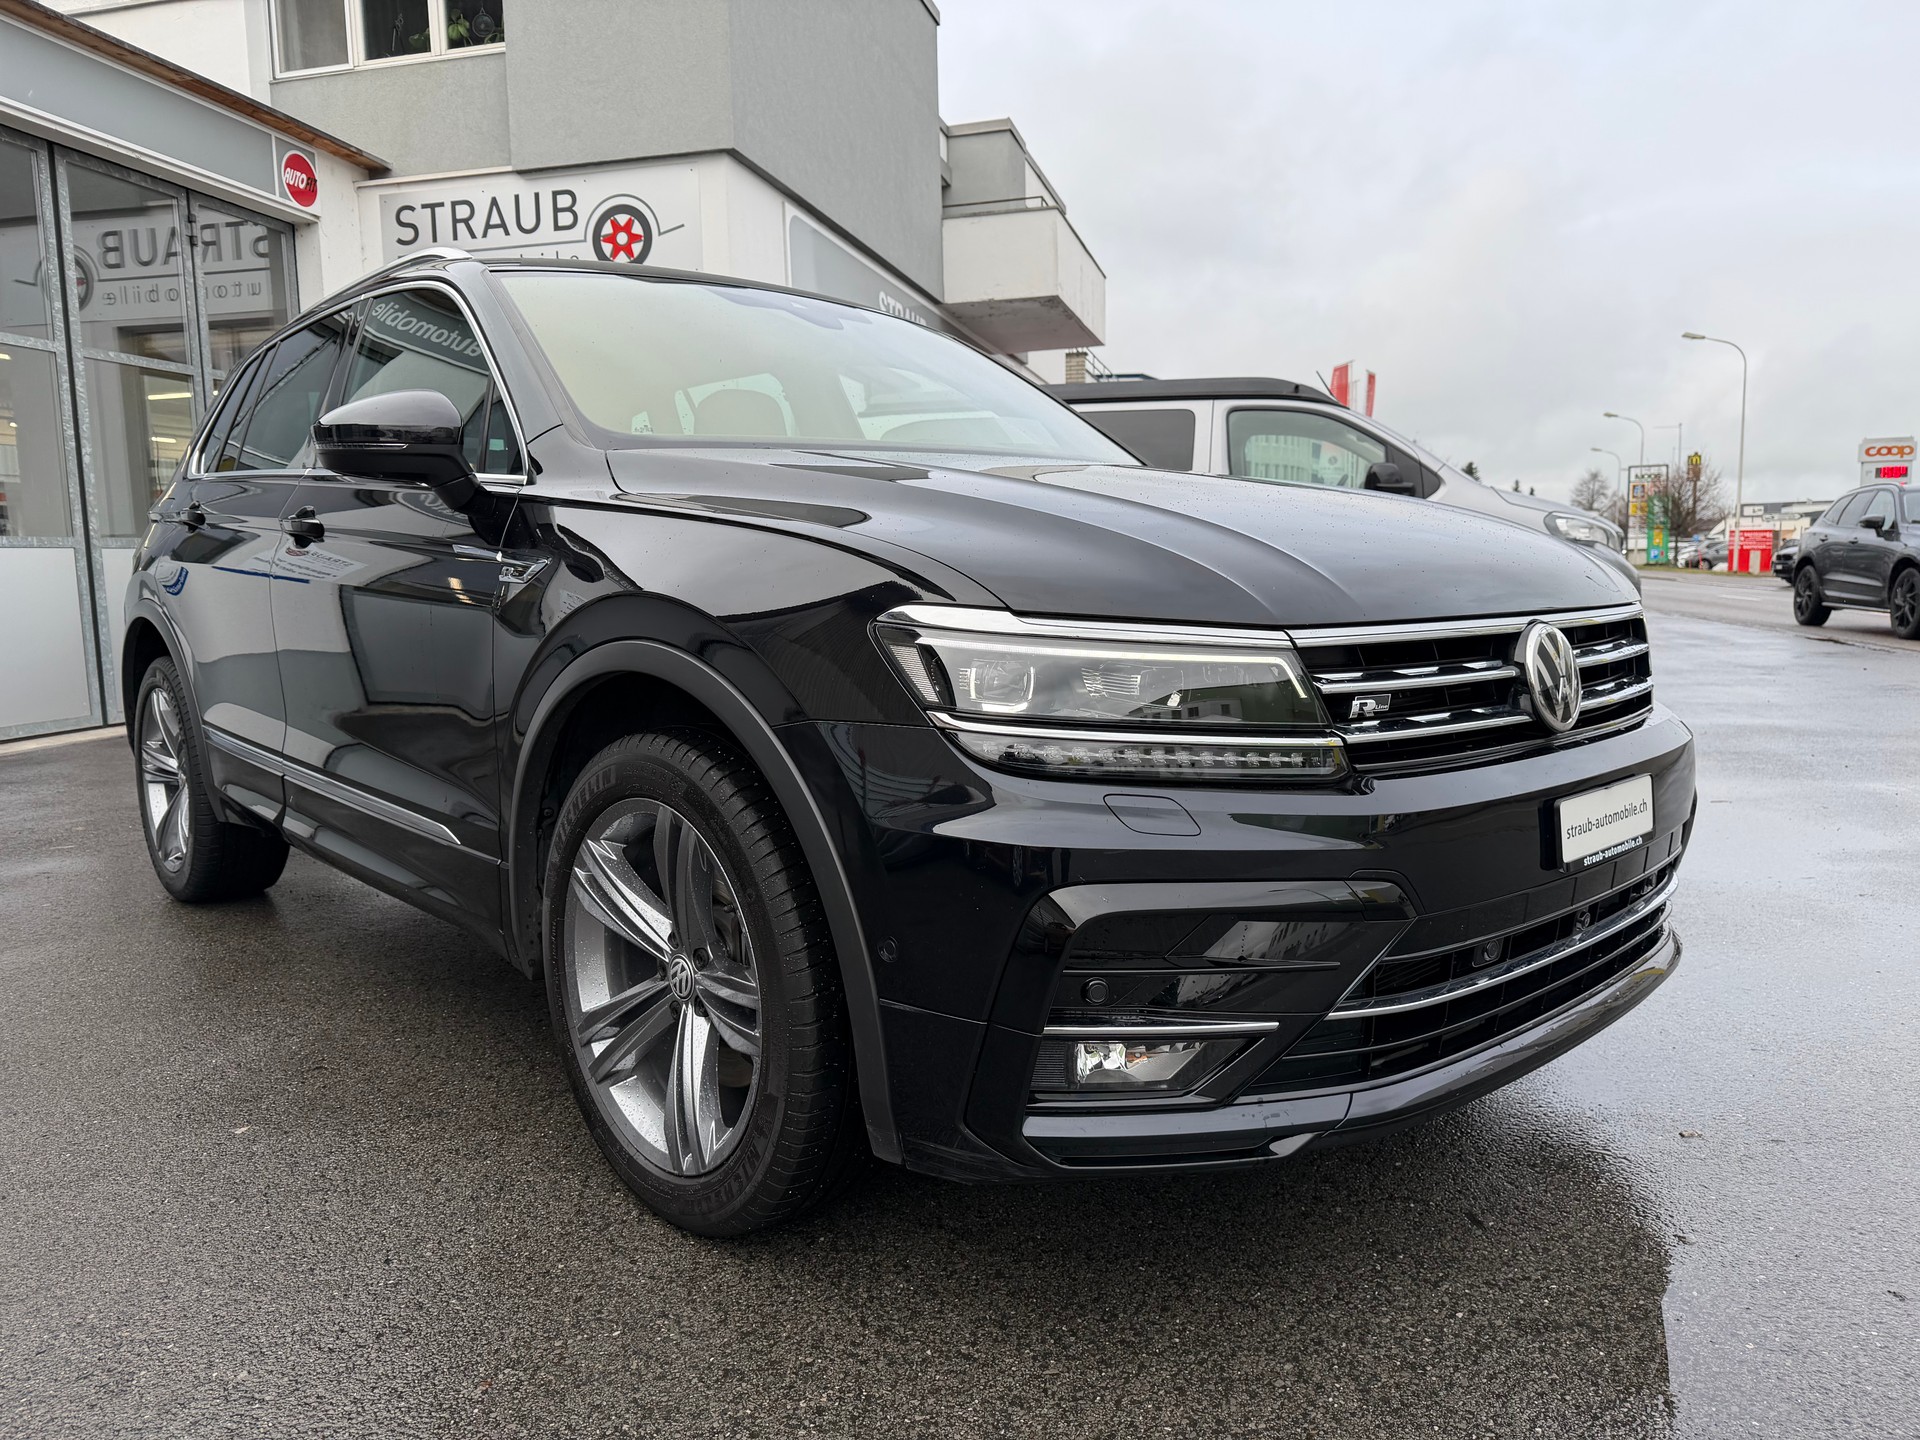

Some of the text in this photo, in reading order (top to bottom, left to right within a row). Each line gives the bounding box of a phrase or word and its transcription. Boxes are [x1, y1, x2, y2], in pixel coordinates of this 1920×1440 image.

[395, 189, 579, 246] STRAUB
[1865, 445, 1915, 459] coop
[1566, 798, 1648, 840] straub-automobile.ch
[1583, 835, 1643, 866] straub-automobile.ch
